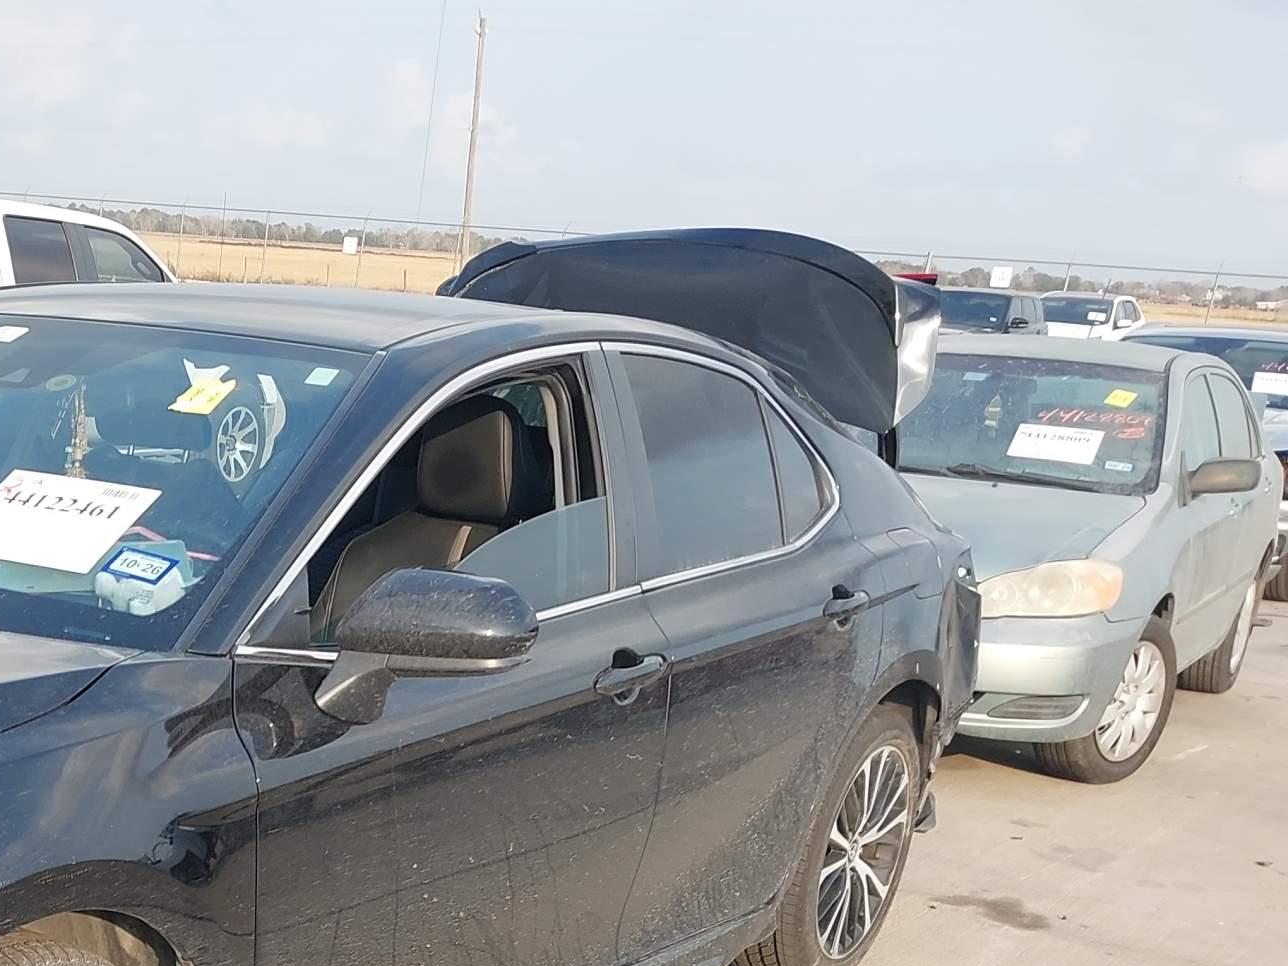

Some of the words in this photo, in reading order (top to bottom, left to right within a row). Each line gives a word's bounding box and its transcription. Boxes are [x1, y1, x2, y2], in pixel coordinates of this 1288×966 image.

[3, 490, 121, 519] 44122461
[119, 557, 138, 570] 10
[141, 563, 163, 575] 26
